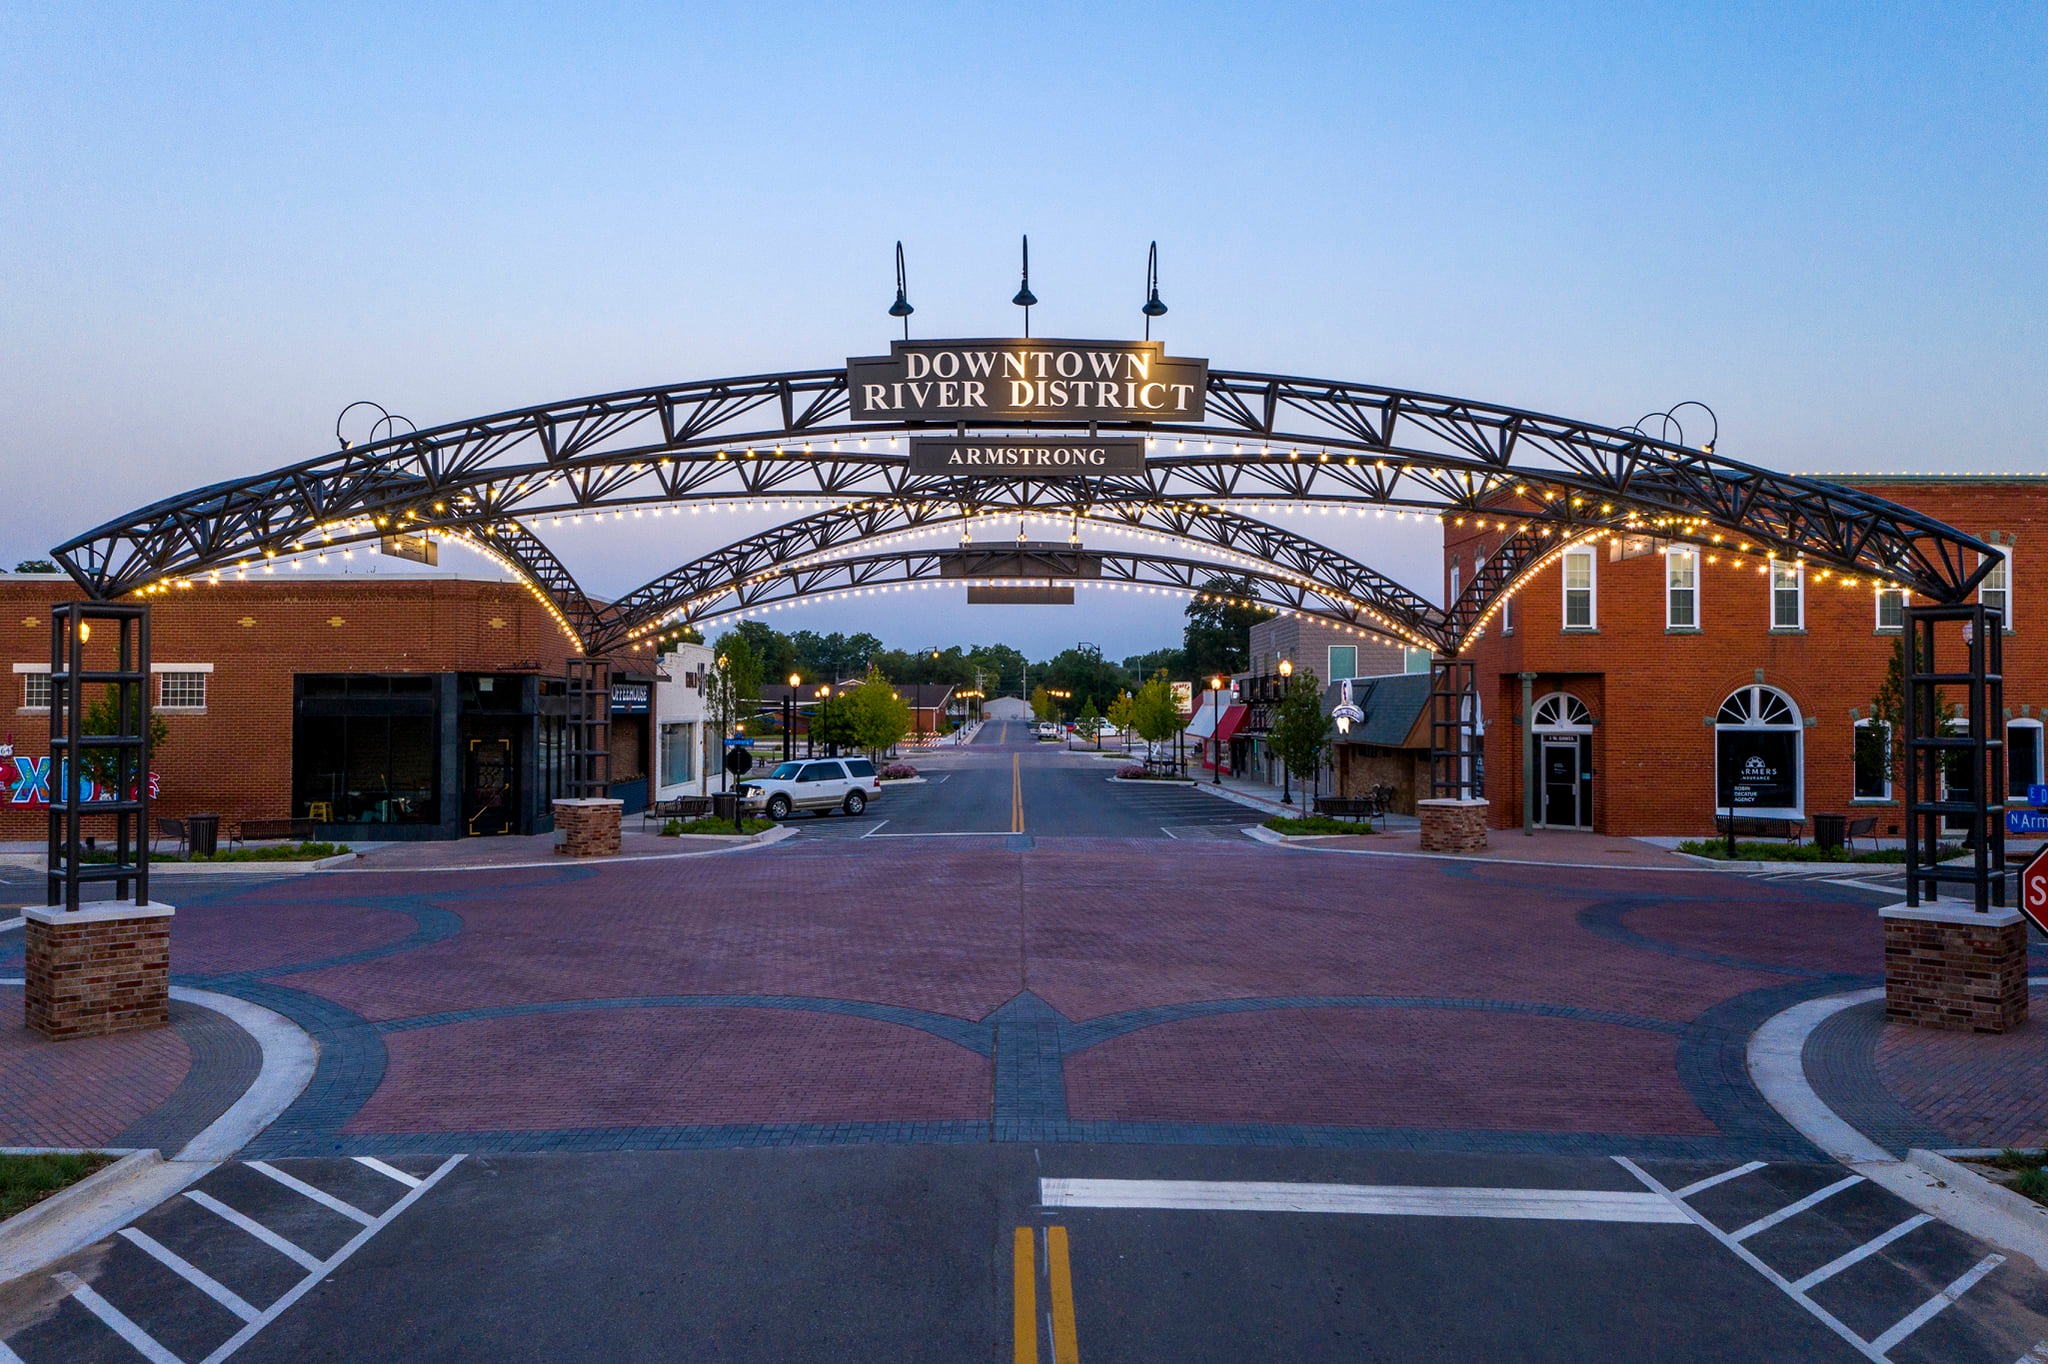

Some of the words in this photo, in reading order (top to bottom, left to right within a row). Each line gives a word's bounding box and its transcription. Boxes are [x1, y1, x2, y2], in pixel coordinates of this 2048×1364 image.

[905, 351, 1151, 380] DOWNTOWN
[863, 381, 988, 411] RIVER
[1009, 381, 1194, 411] DISTRICT
[947, 447, 1106, 466] ARMSTRONG
[611, 684, 647, 702] OFFEEHOUSE
[2011, 813, 2018, 824] N
[2030, 876, 2048, 906] S
